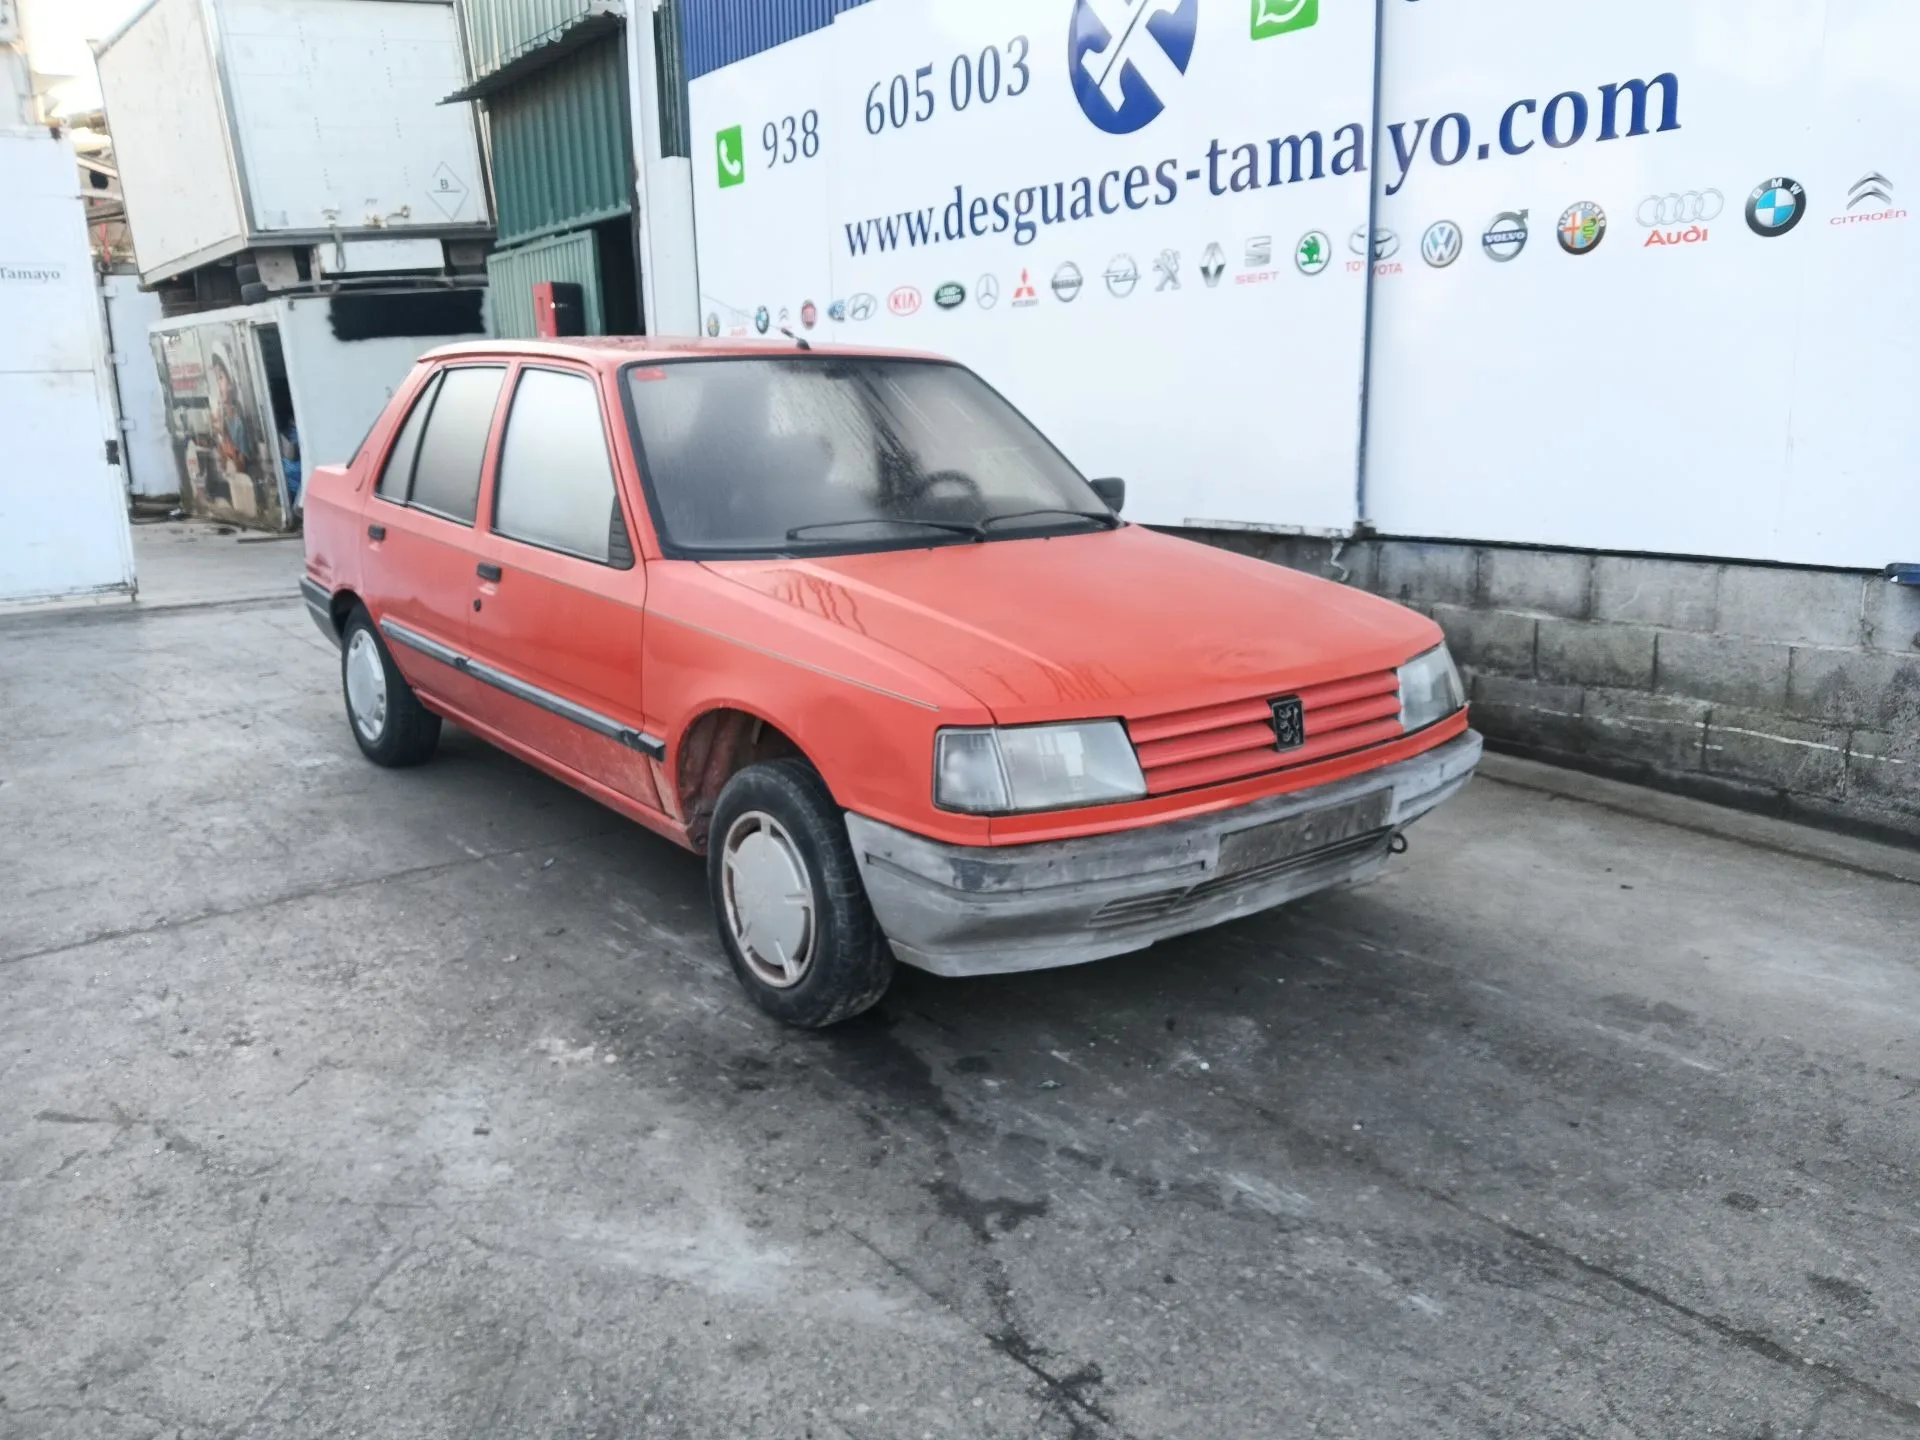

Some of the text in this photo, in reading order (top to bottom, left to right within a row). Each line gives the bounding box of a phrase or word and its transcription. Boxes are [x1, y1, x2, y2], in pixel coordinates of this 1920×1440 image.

[762, 34, 1031, 168] 938 605 003
[845, 71, 1682, 256] www.desguaces-tamayo.com
[1485, 231, 1526, 244] VOLVO
[893, 291, 917, 309] KIA
